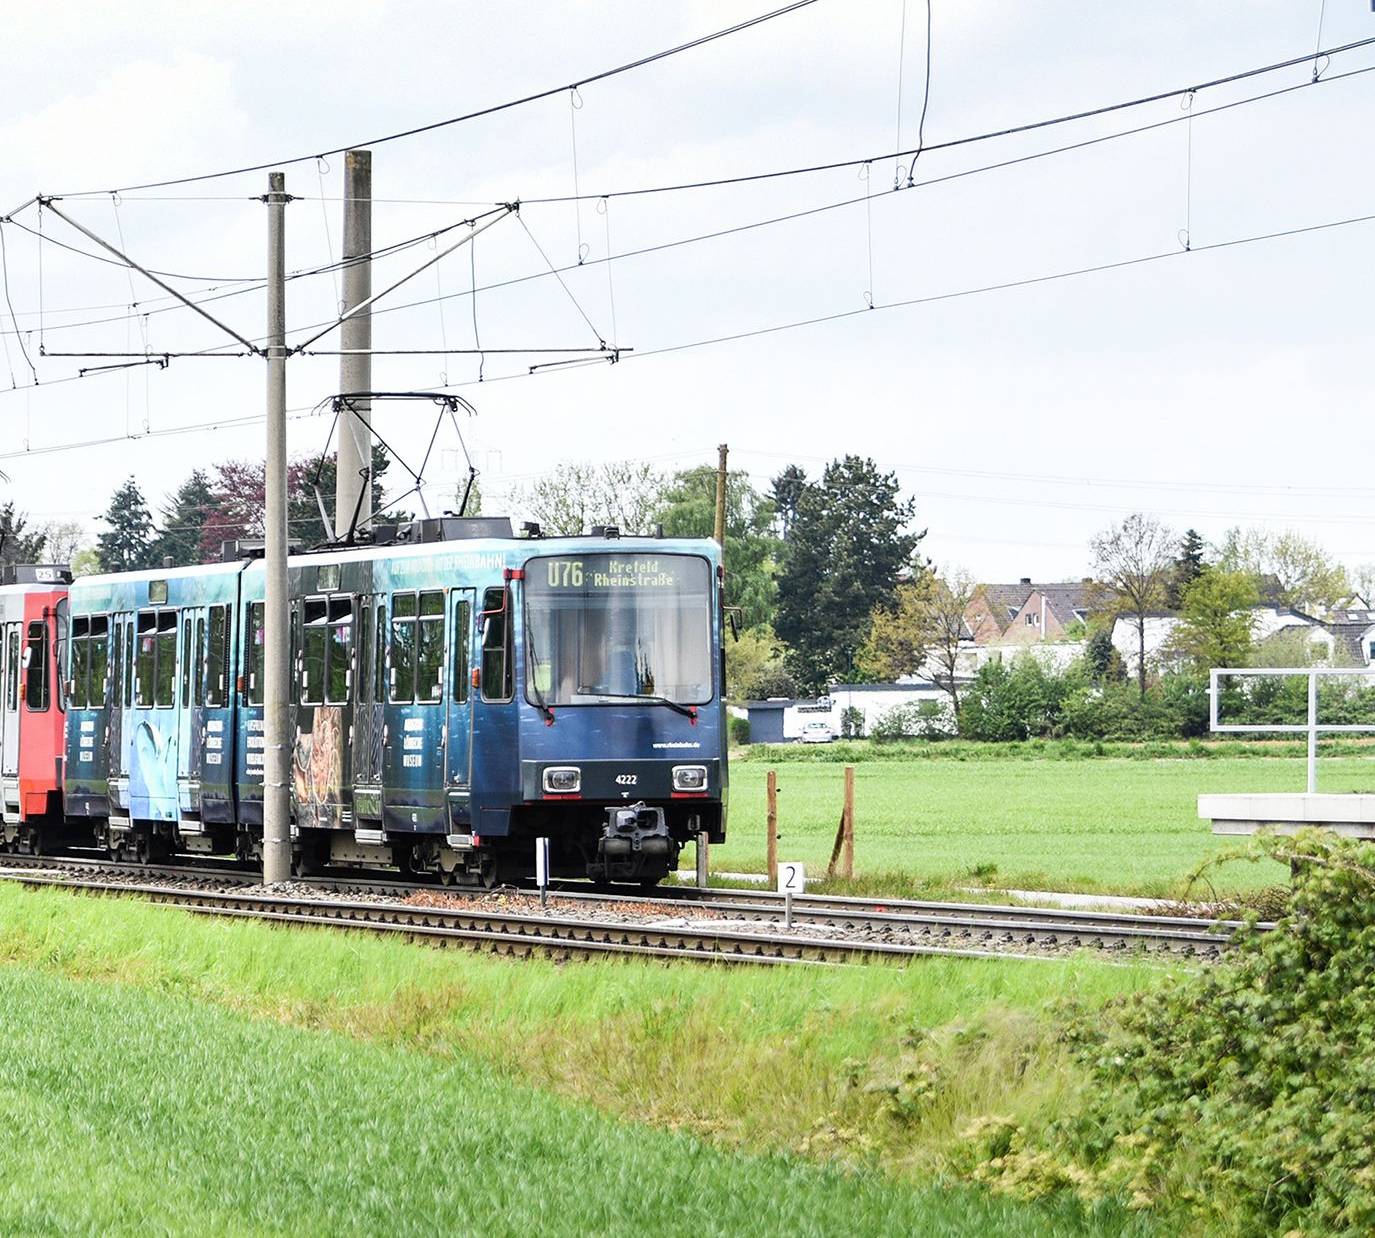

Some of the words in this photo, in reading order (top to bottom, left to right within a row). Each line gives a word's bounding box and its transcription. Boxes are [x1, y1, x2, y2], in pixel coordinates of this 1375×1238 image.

[609, 559, 659, 573] Krefeld
[547, 561, 584, 587] U76
[593, 572, 673, 587] Rheinstraße
[615, 774, 638, 785] 4222
[785, 865, 797, 888] 2
